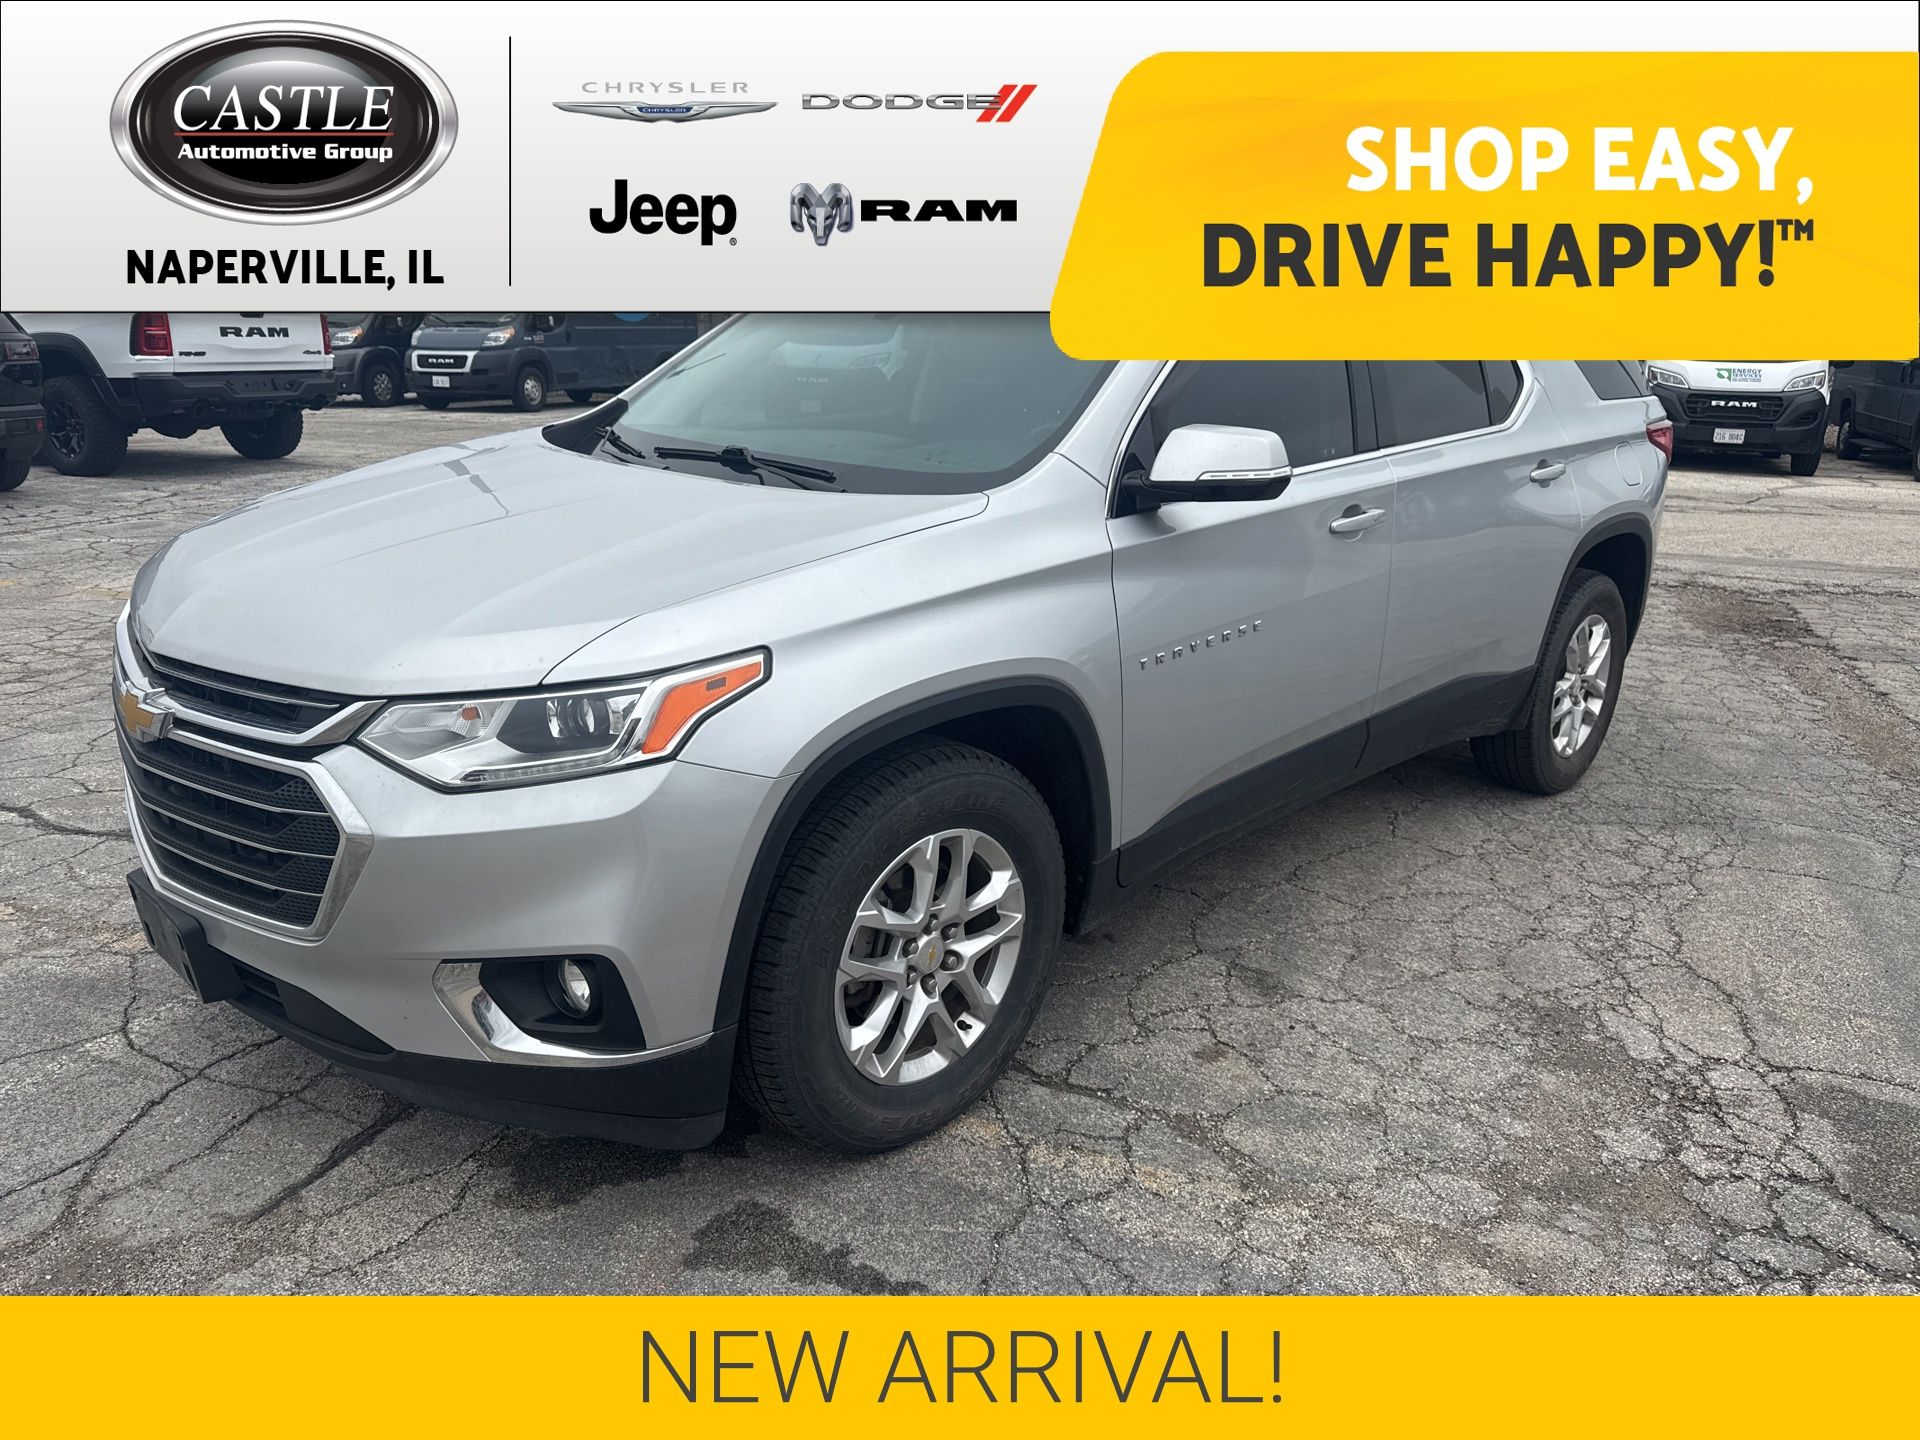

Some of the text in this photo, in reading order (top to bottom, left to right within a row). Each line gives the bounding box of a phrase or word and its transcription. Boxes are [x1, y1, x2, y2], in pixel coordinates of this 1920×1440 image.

[219, 326, 290, 338] RAM
[1732, 367, 1762, 375] ENERGY
[1711, 400, 1758, 408] RAM
[1139, 620, 1264, 671] TRAVERSE
